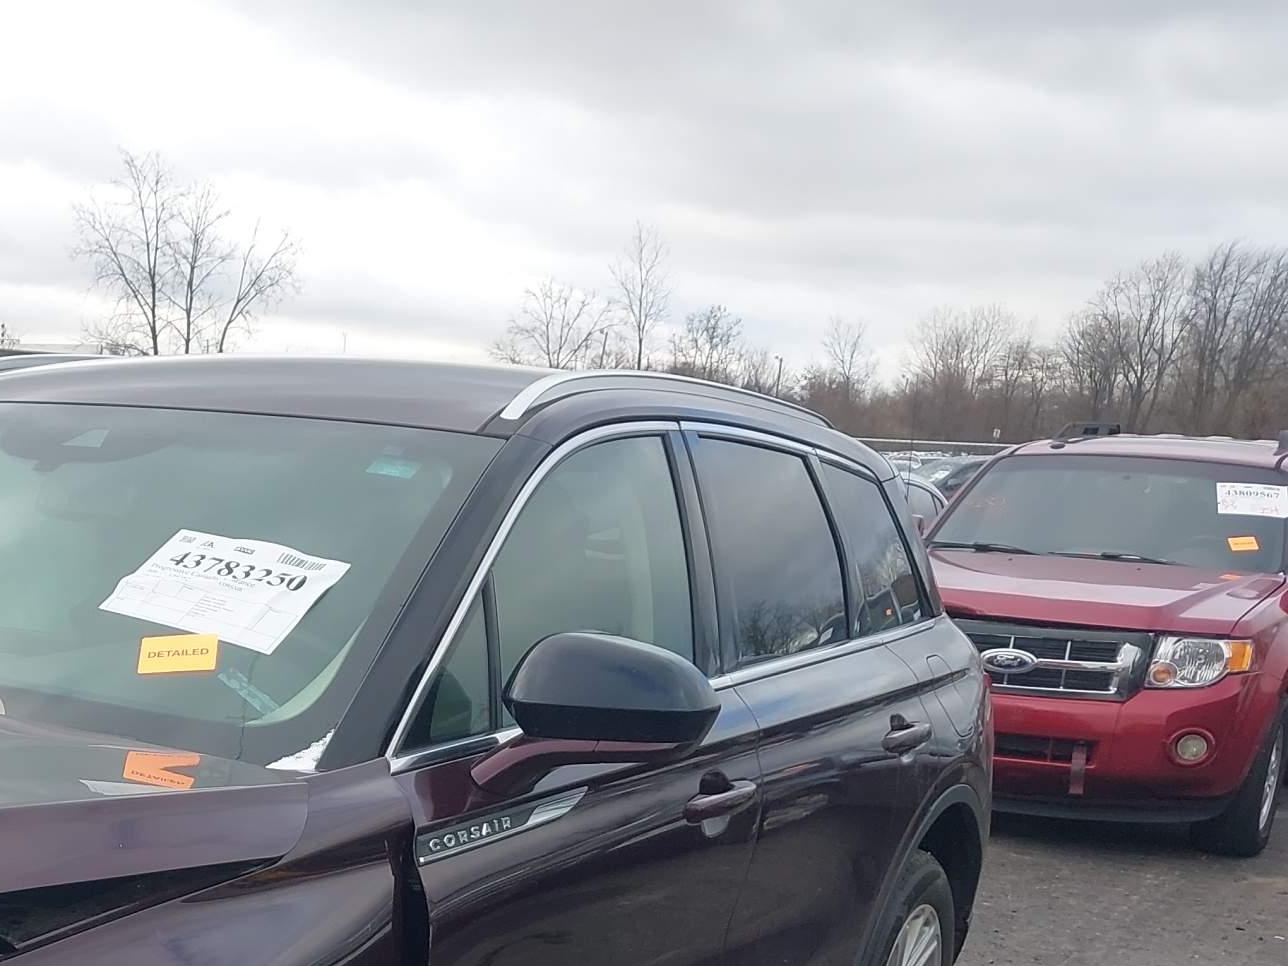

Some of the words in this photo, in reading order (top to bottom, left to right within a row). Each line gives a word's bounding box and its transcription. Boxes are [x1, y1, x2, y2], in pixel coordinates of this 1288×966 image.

[169, 551, 308, 591] 43783250
[147, 647, 209, 659] DETAILED
[428, 816, 512, 851] CORSAIR
